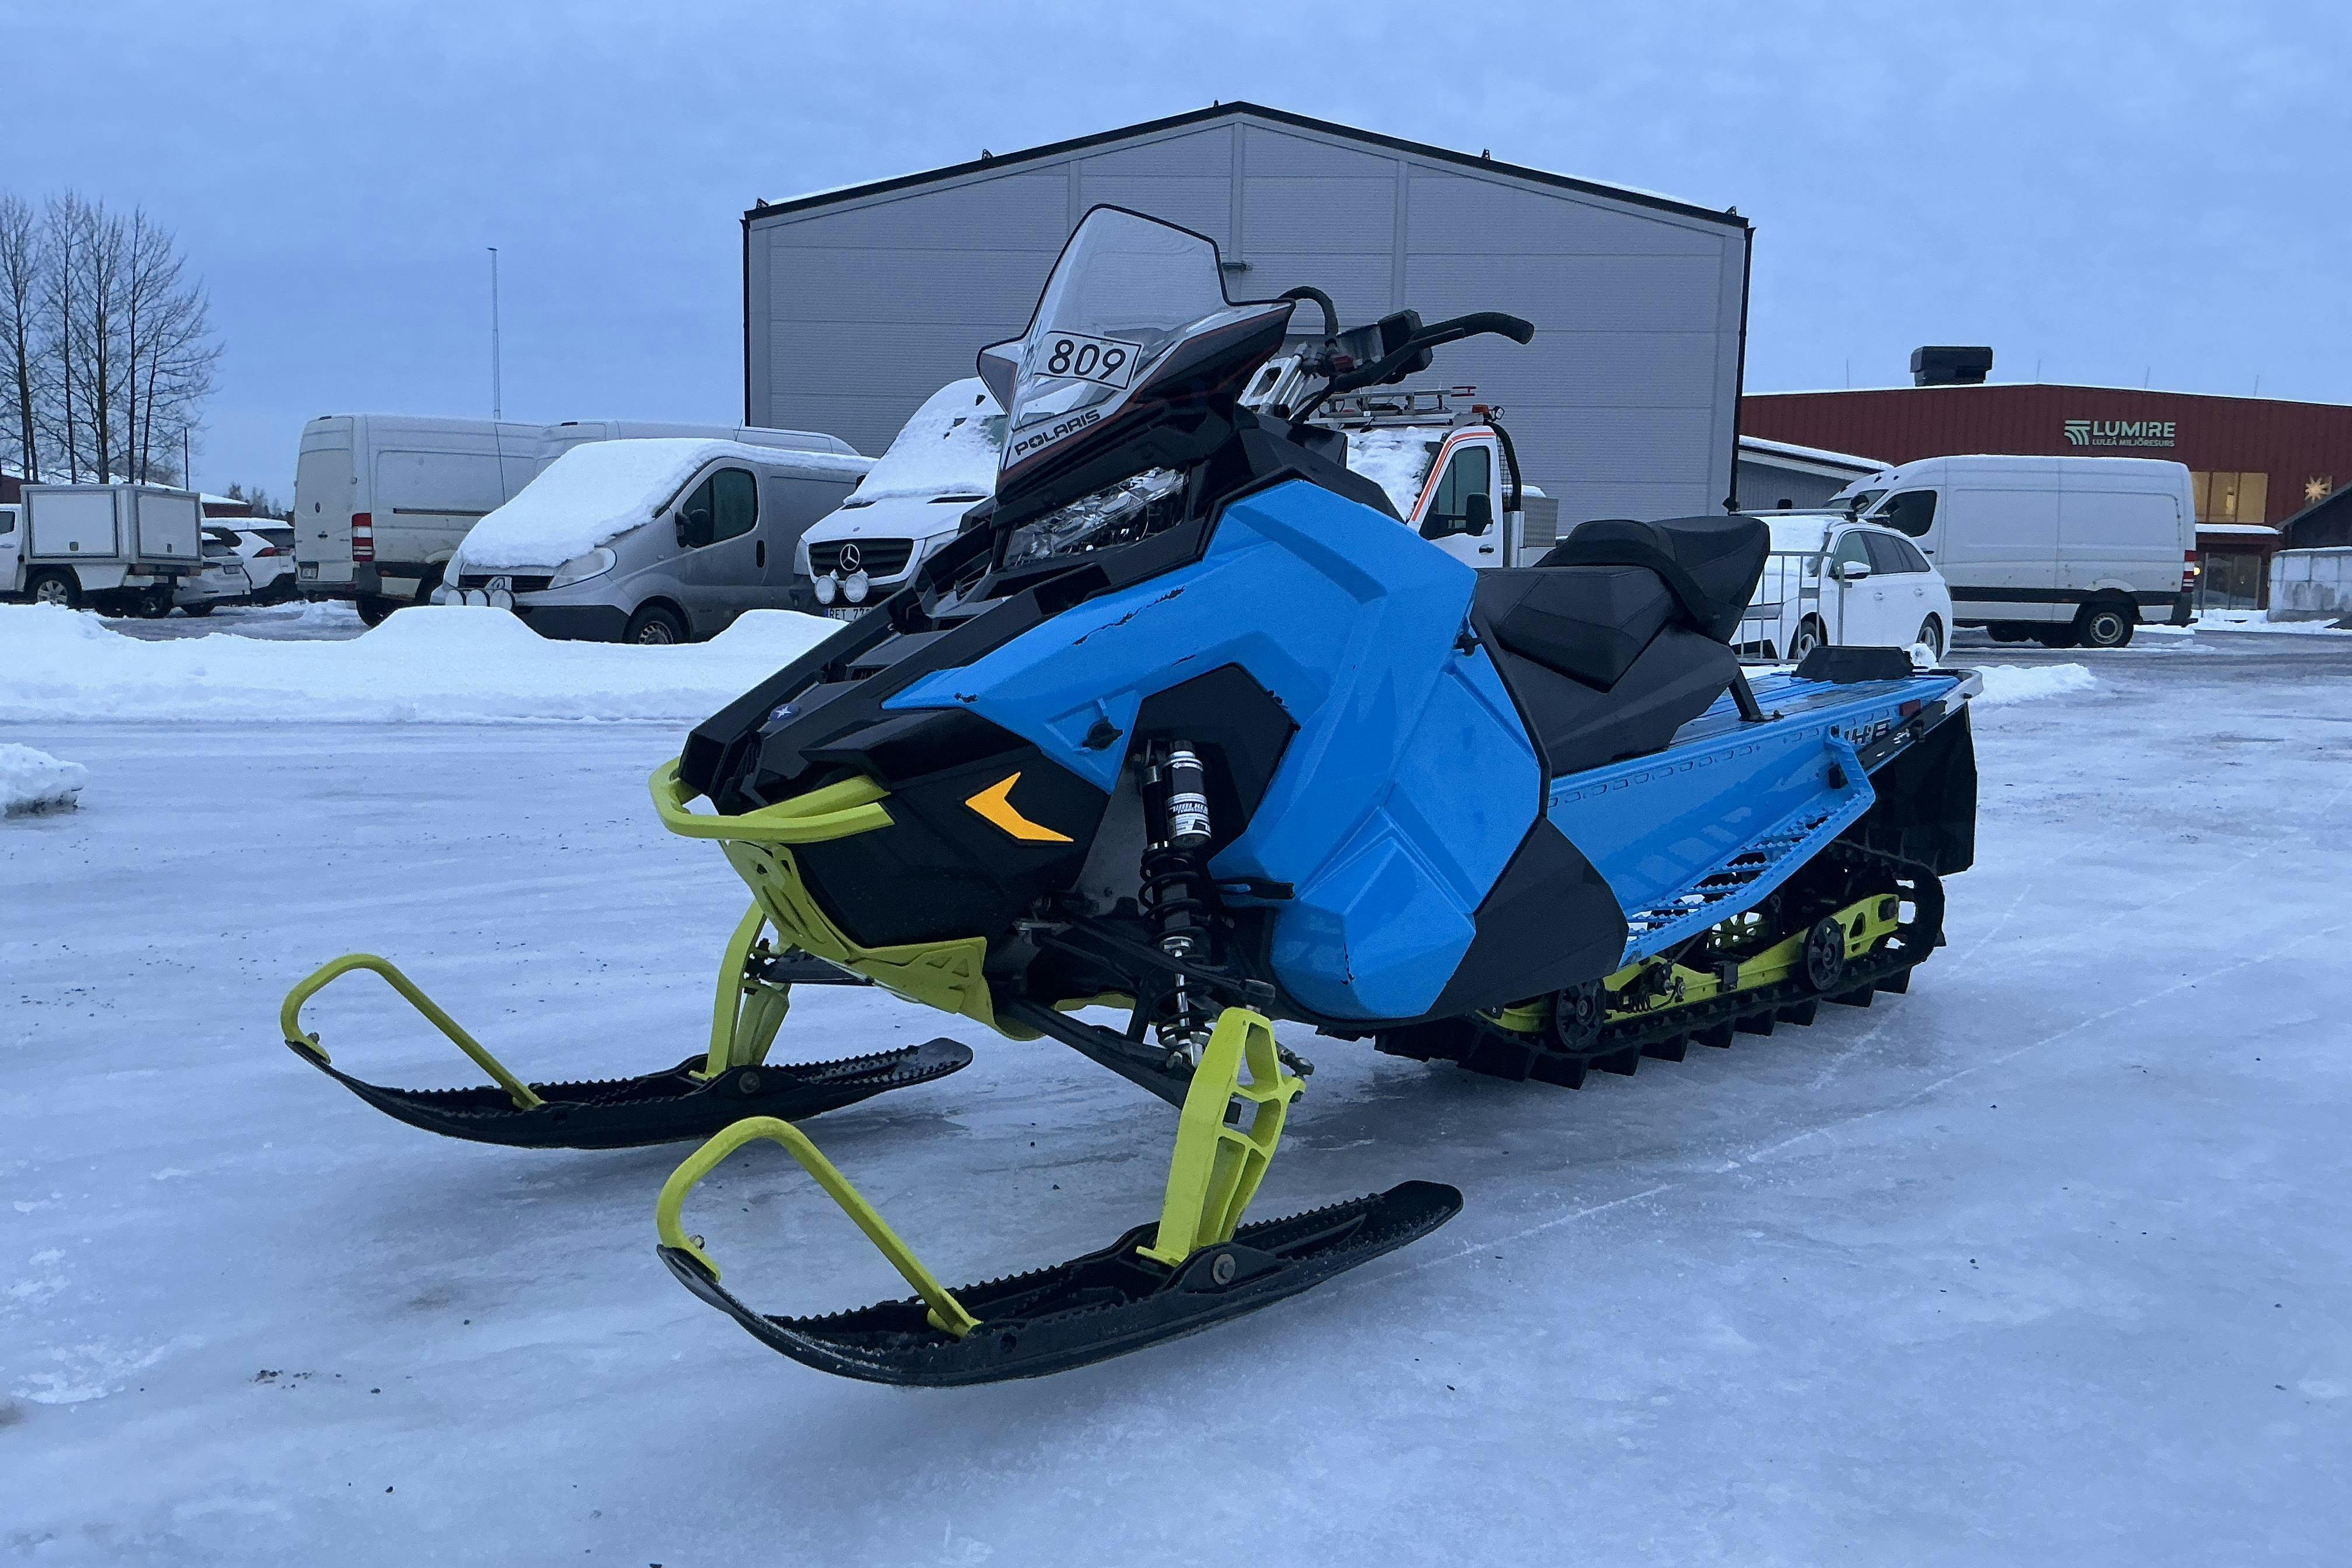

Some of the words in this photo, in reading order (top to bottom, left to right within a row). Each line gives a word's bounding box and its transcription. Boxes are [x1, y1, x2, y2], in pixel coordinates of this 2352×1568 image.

[1048, 339, 1126, 380] 809
[1014, 409, 1101, 456] POLARIS
[2092, 421, 2176, 438] LUMIRE
[2092, 437, 2118, 446] LULEÅ
[2119, 438, 2175, 447] MILJÖRESURS
[829, 608, 846, 620] RET
[853, 608, 870, 620] 77
